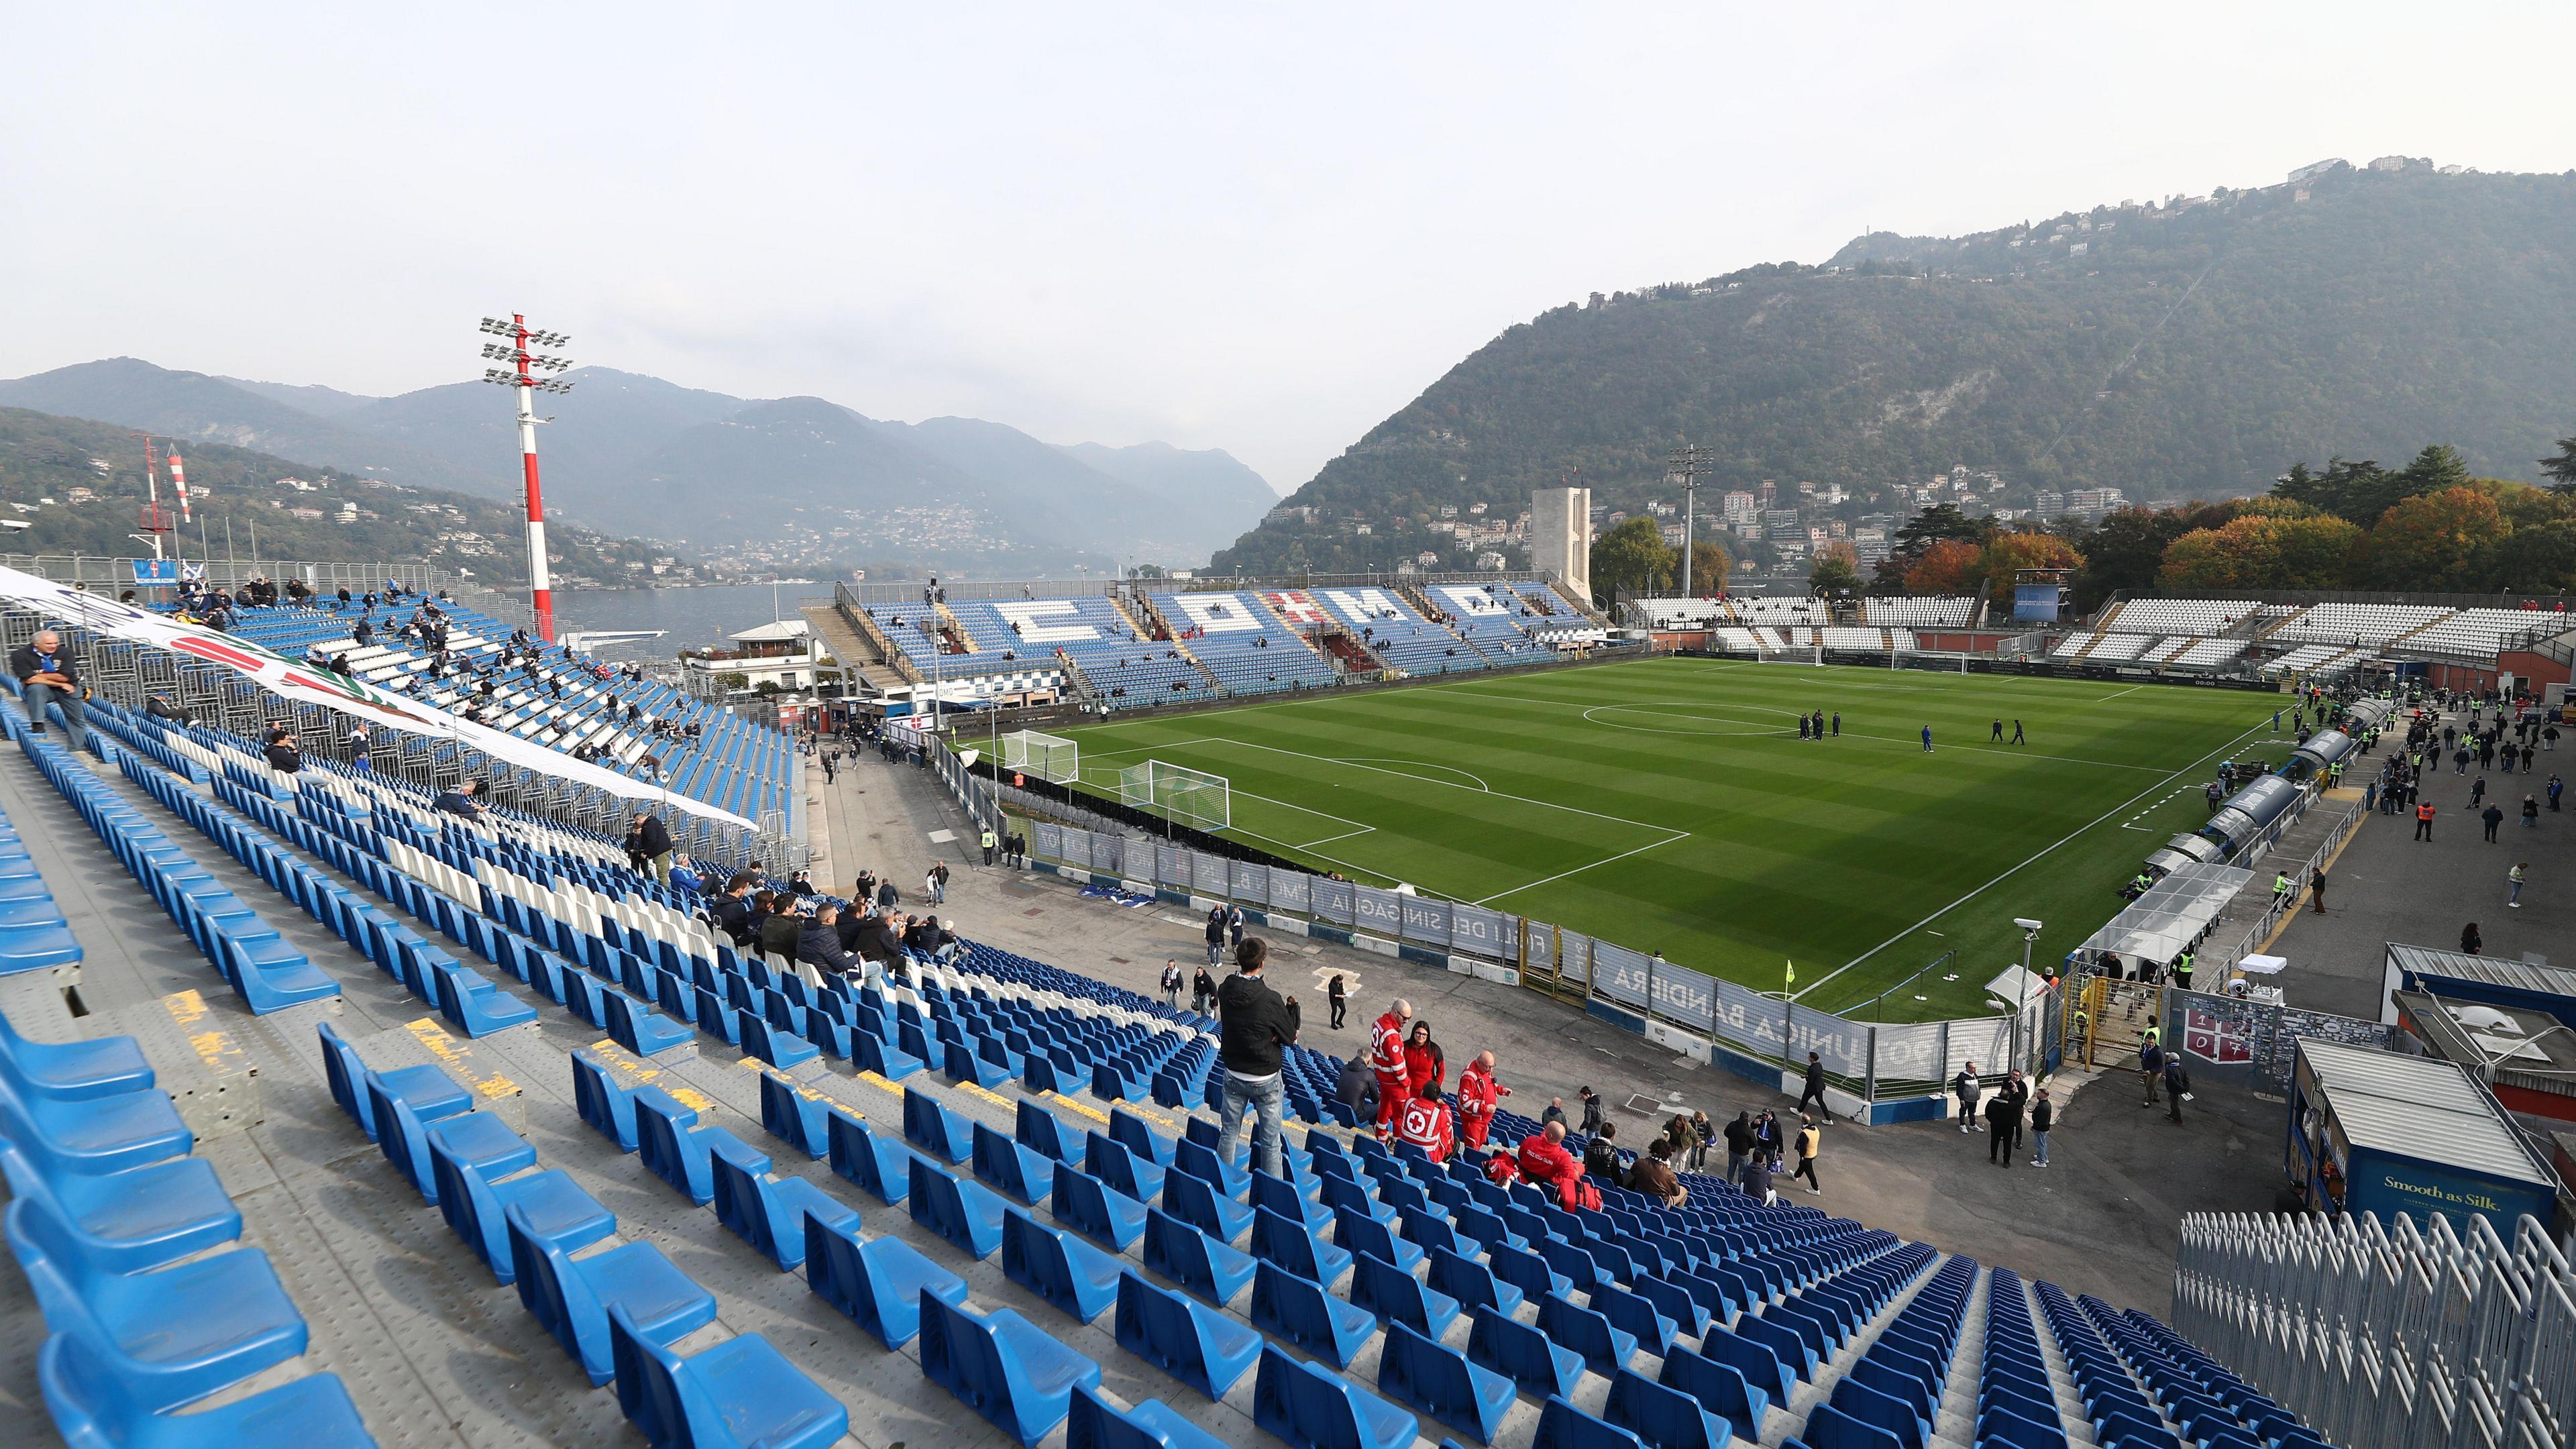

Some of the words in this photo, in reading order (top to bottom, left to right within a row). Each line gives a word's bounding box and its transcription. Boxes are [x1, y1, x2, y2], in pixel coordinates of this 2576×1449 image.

[1668, 622, 1684, 630] GRUPPO
[1685, 621, 1703, 630] STORICO
[2384, 1175, 2443, 1199] Smooth
[2446, 1192, 2463, 1203] as
[2465, 1193, 2502, 1212] Silk.
